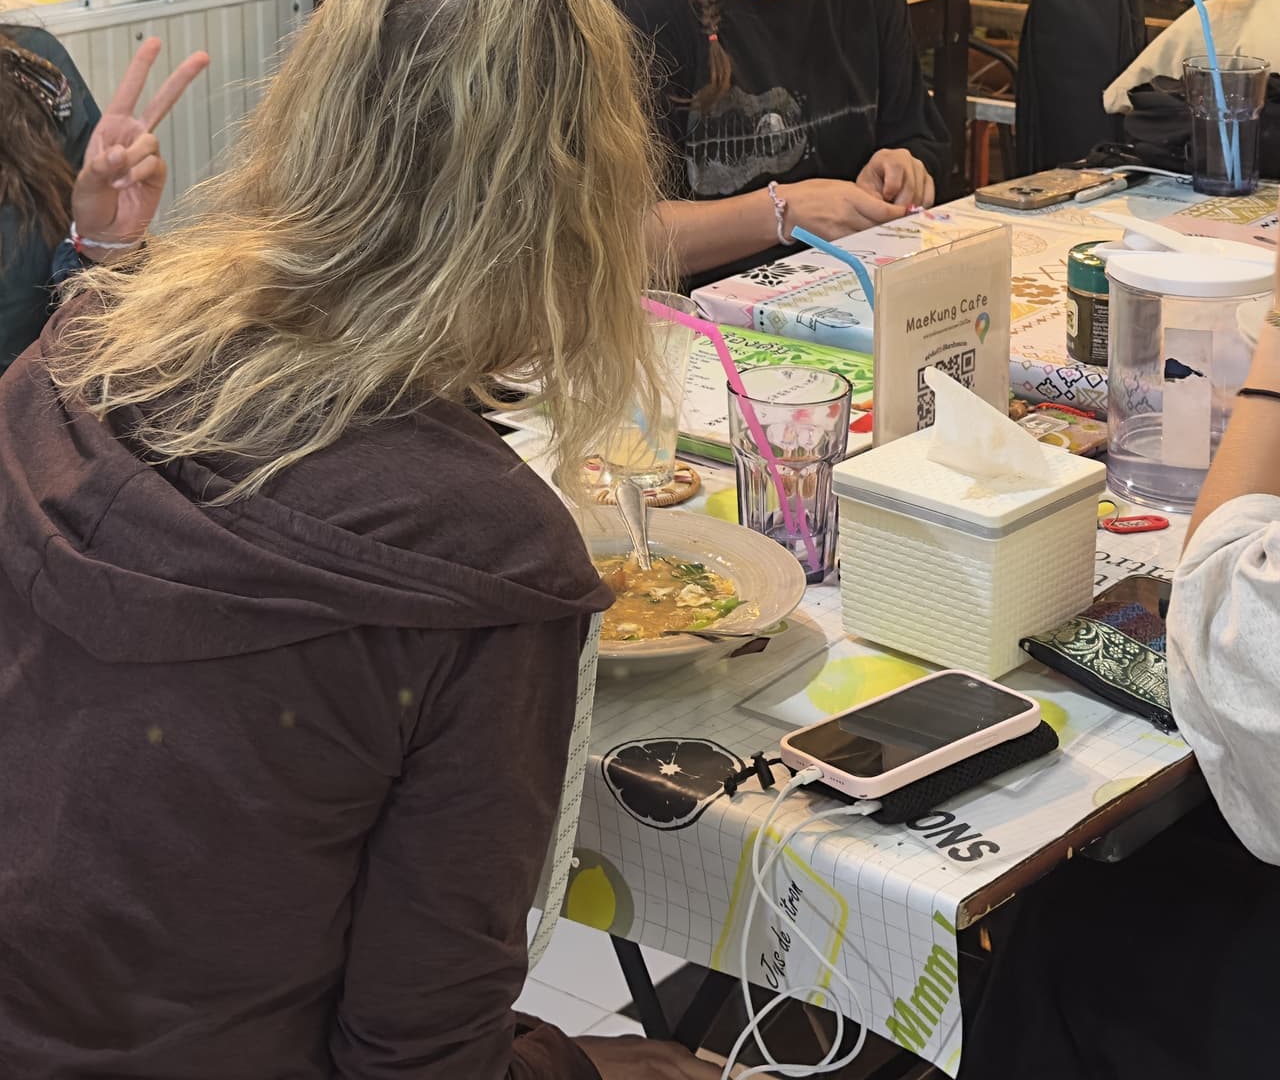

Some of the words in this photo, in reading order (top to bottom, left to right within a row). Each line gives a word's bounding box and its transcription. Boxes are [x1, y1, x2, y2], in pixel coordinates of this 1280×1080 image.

[906, 305, 957, 334] MaeKung
[960, 294, 988, 313] Cafe
[771, 926, 794, 953] de
[885, 944, 958, 1053] Mmm
